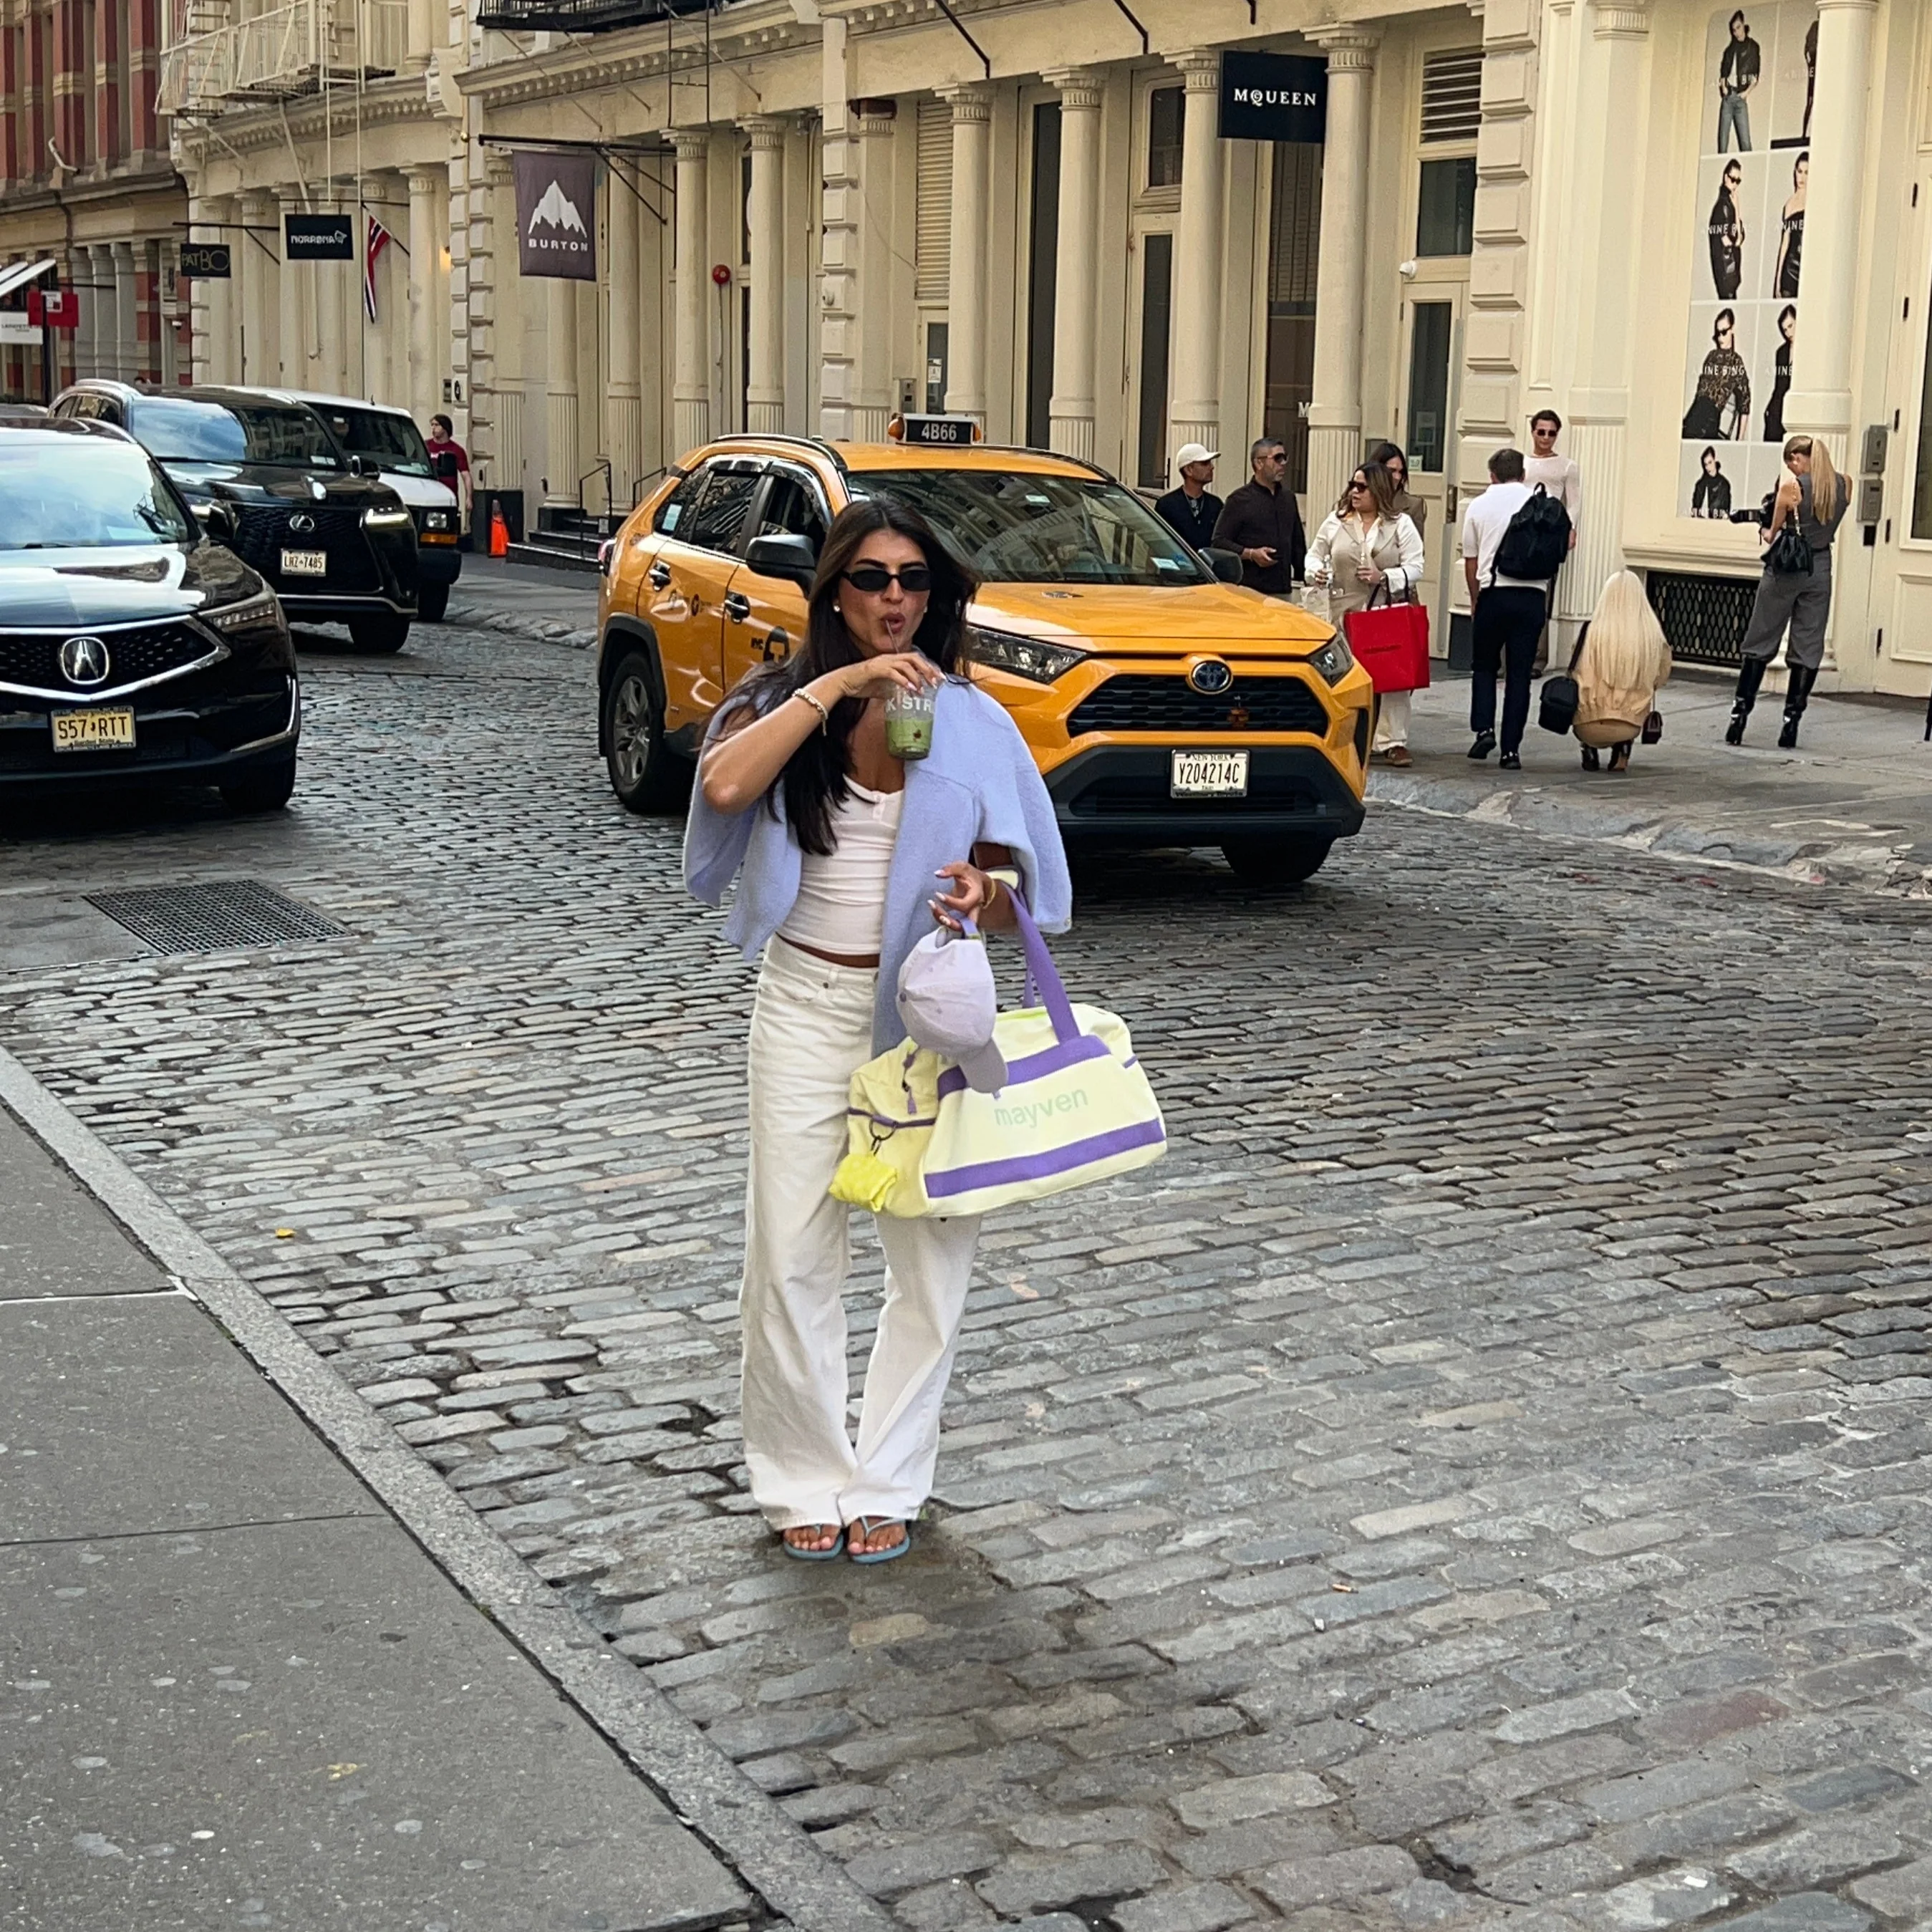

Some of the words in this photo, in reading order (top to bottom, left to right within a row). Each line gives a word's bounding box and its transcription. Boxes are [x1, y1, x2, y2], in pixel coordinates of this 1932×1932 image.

[528, 238, 588, 251] BURTON
[921, 422, 957, 442] 4B66
[58, 719, 87, 740] S57
[98, 716, 127, 736] RTT
[1179, 763, 1240, 783] Y204214C
[994, 1088, 1088, 1129] mayven
